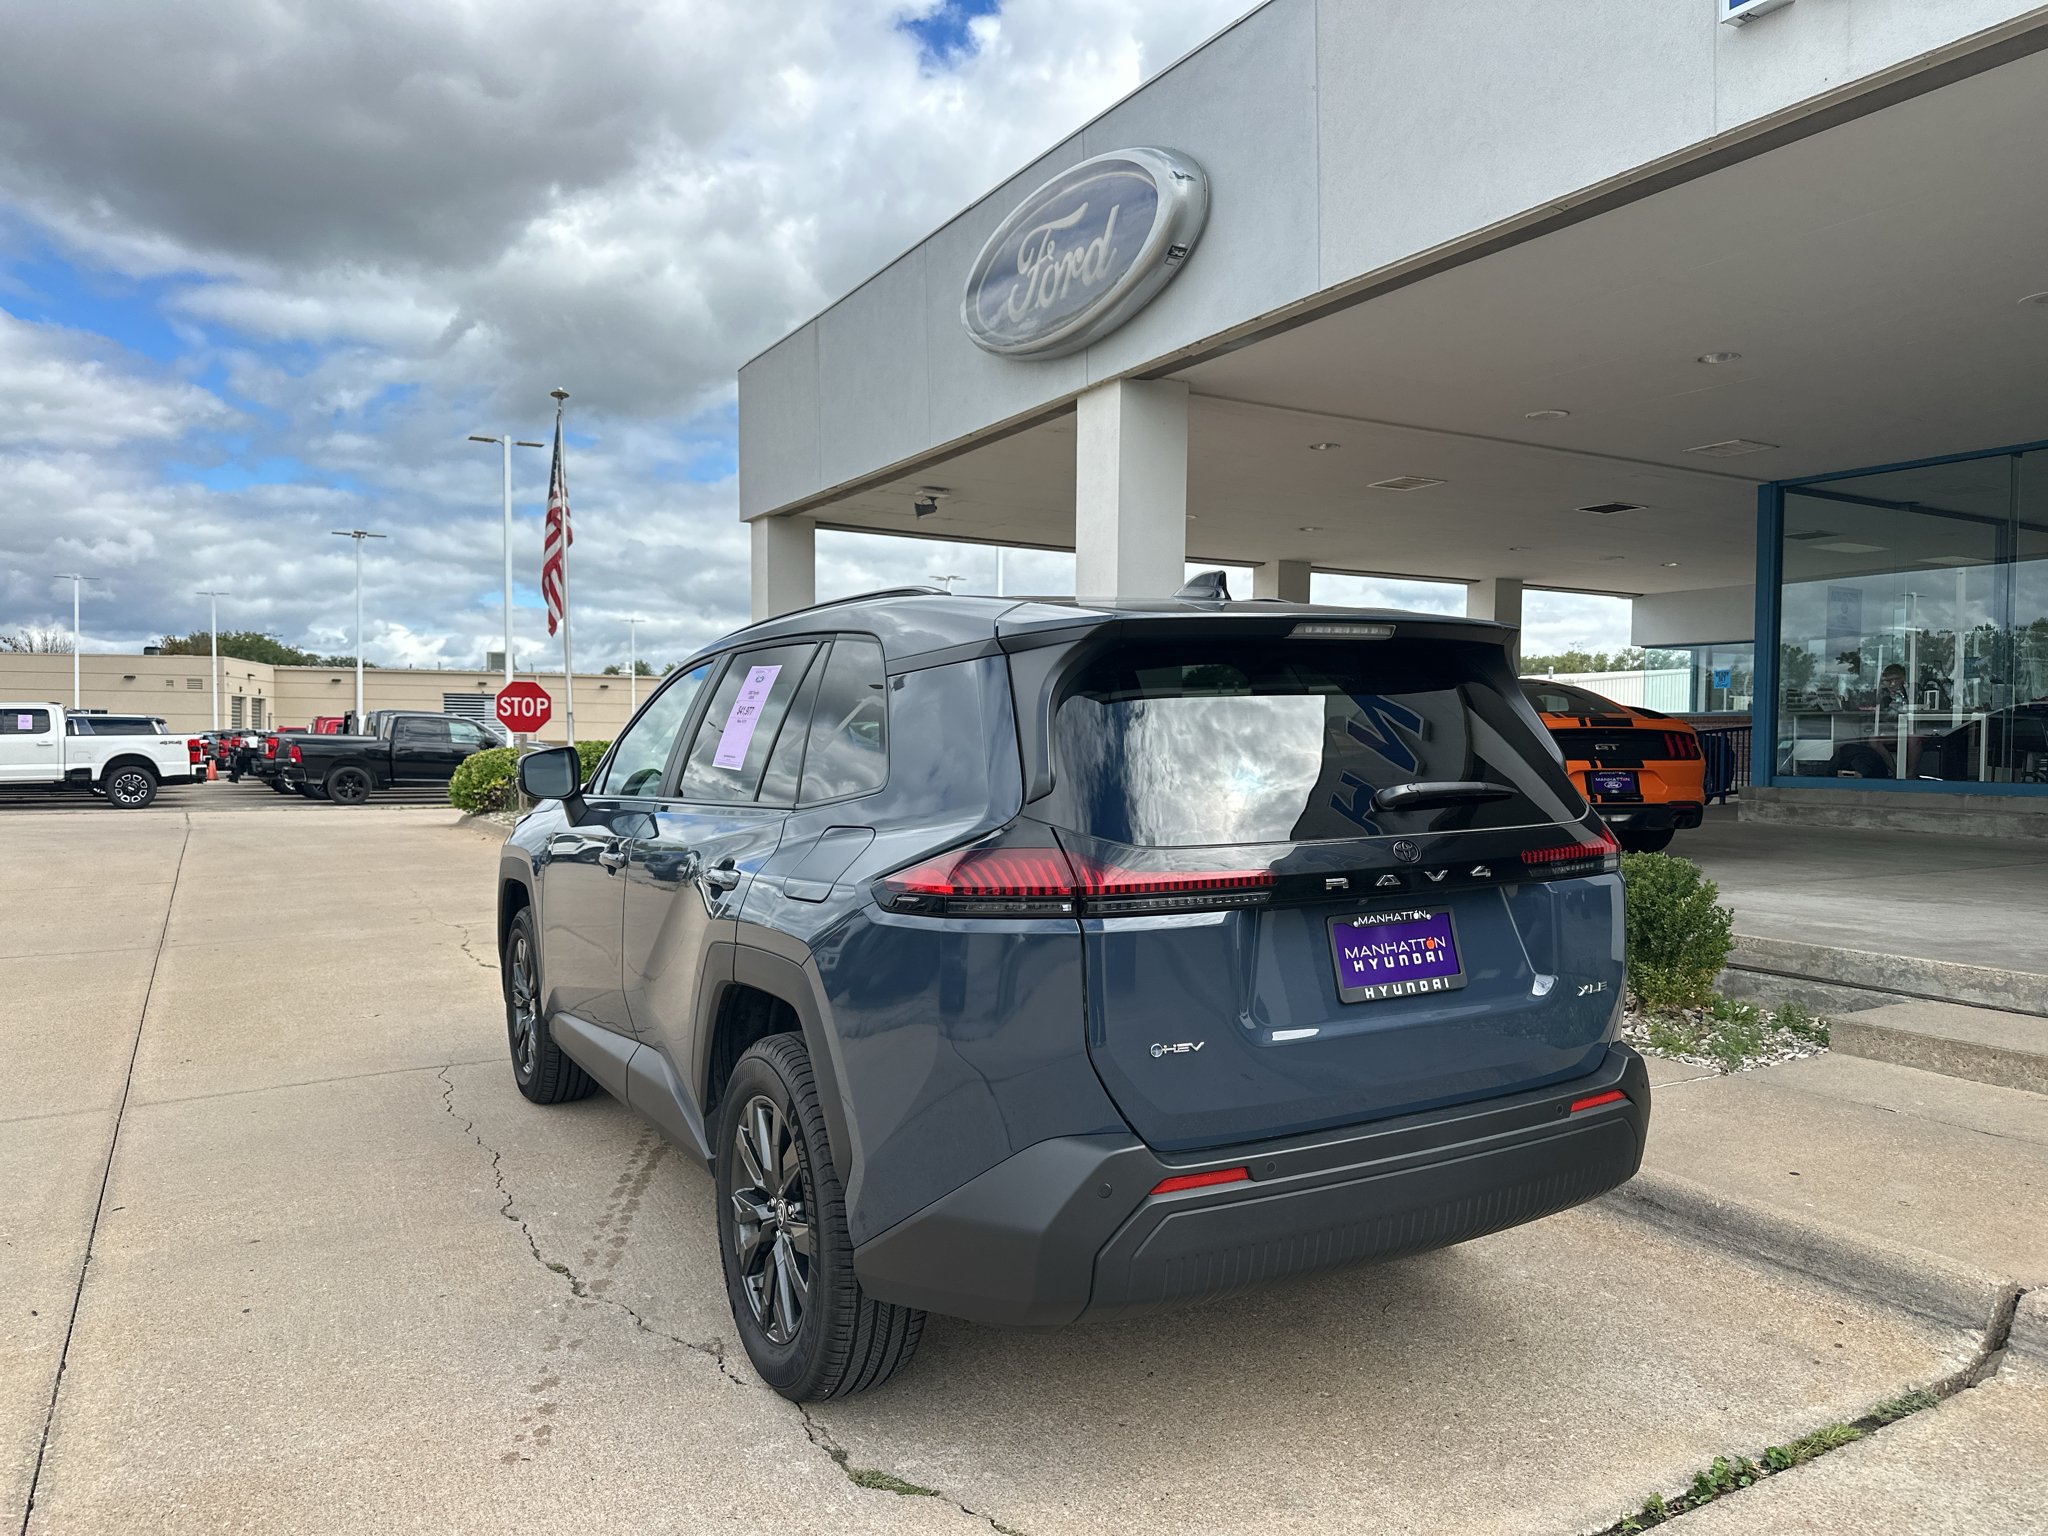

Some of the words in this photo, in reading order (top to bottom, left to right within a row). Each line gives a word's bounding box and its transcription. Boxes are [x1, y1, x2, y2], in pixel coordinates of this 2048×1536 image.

[1008, 202, 1119, 322] Ford
[499, 696, 549, 717] STOP
[1326, 865, 1492, 890] RAV4
[1353, 950, 1444, 972] HYUNDAI
[1364, 977, 1450, 999] HYUNDAI
[1576, 981, 1608, 997] XLE
[1162, 1041, 1205, 1053] HEV
[795, 1139, 818, 1259] MICHELIN
